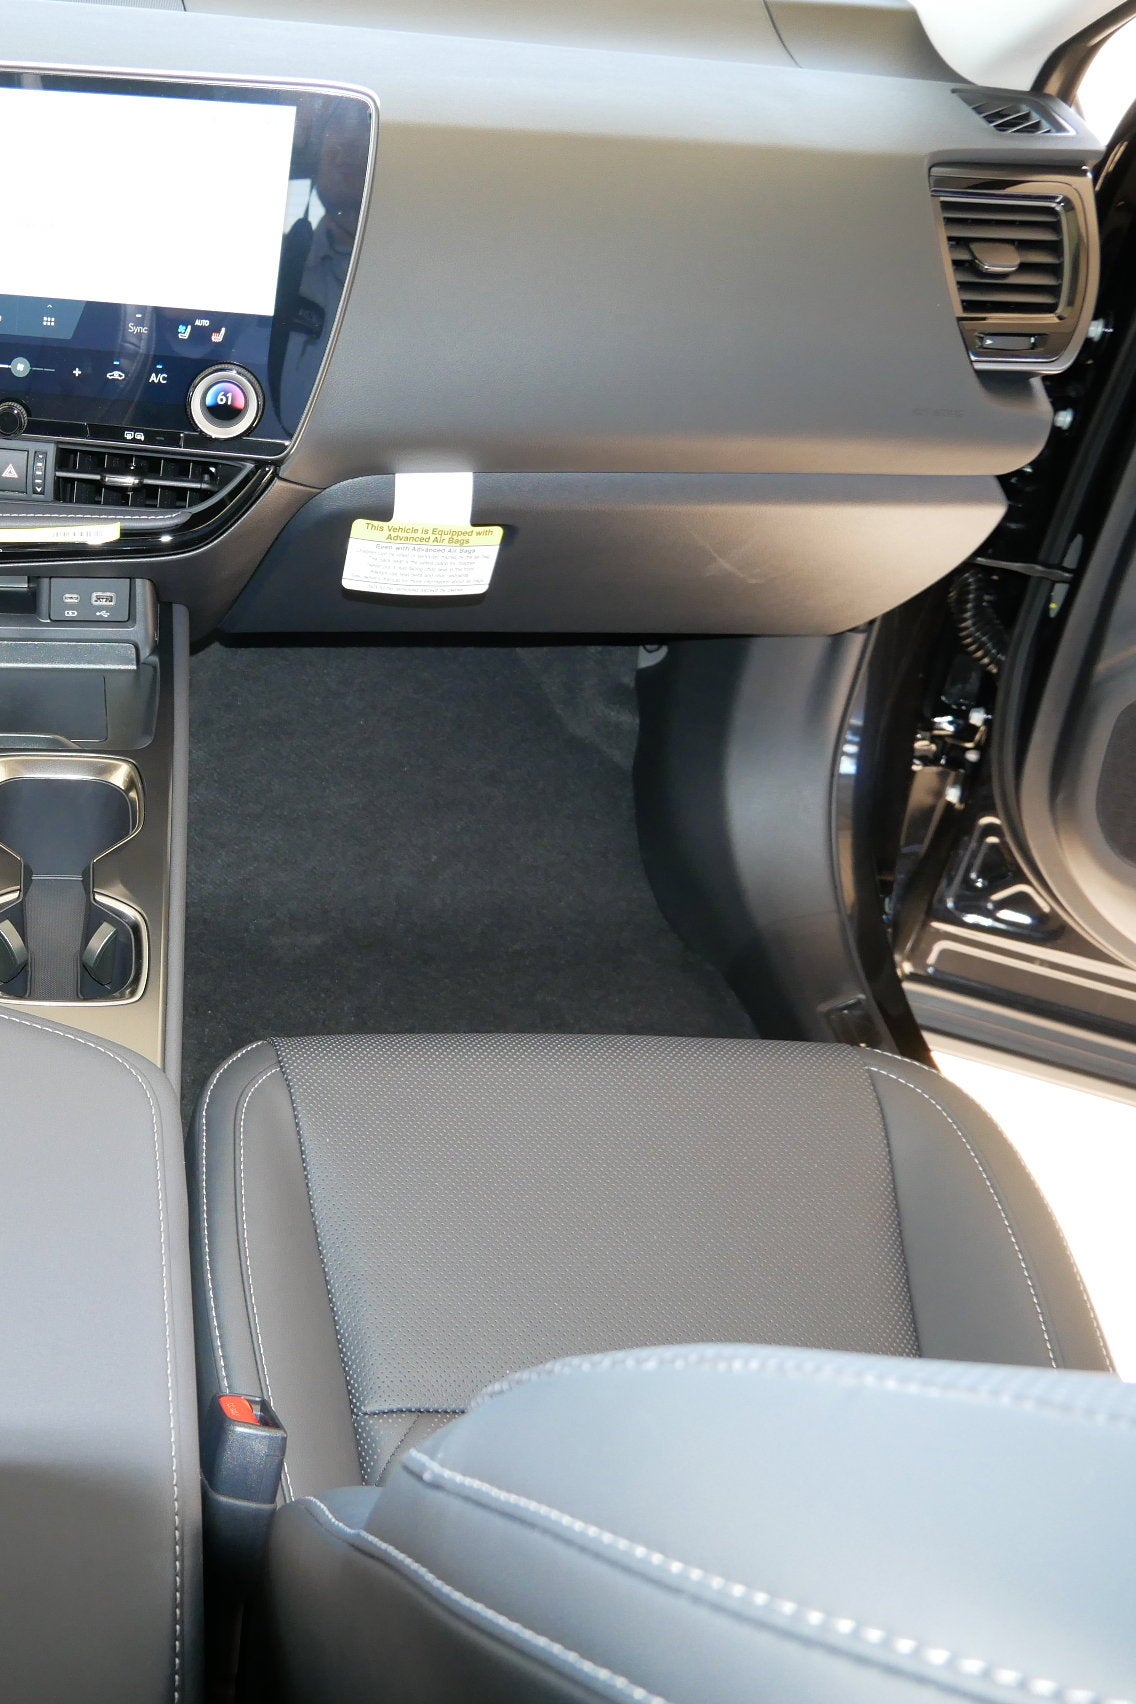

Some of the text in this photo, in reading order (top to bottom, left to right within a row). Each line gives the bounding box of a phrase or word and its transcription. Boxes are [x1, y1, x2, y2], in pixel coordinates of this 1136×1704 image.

[128, 322, 149, 335] Sync
[194, 319, 210, 327] AUTO
[149, 373, 168, 384] A/C
[216, 392, 233, 405] 61
[365, 523, 493, 538] This Vehicle is Equipped with
[385, 533, 470, 546] Advanced Air Bags
